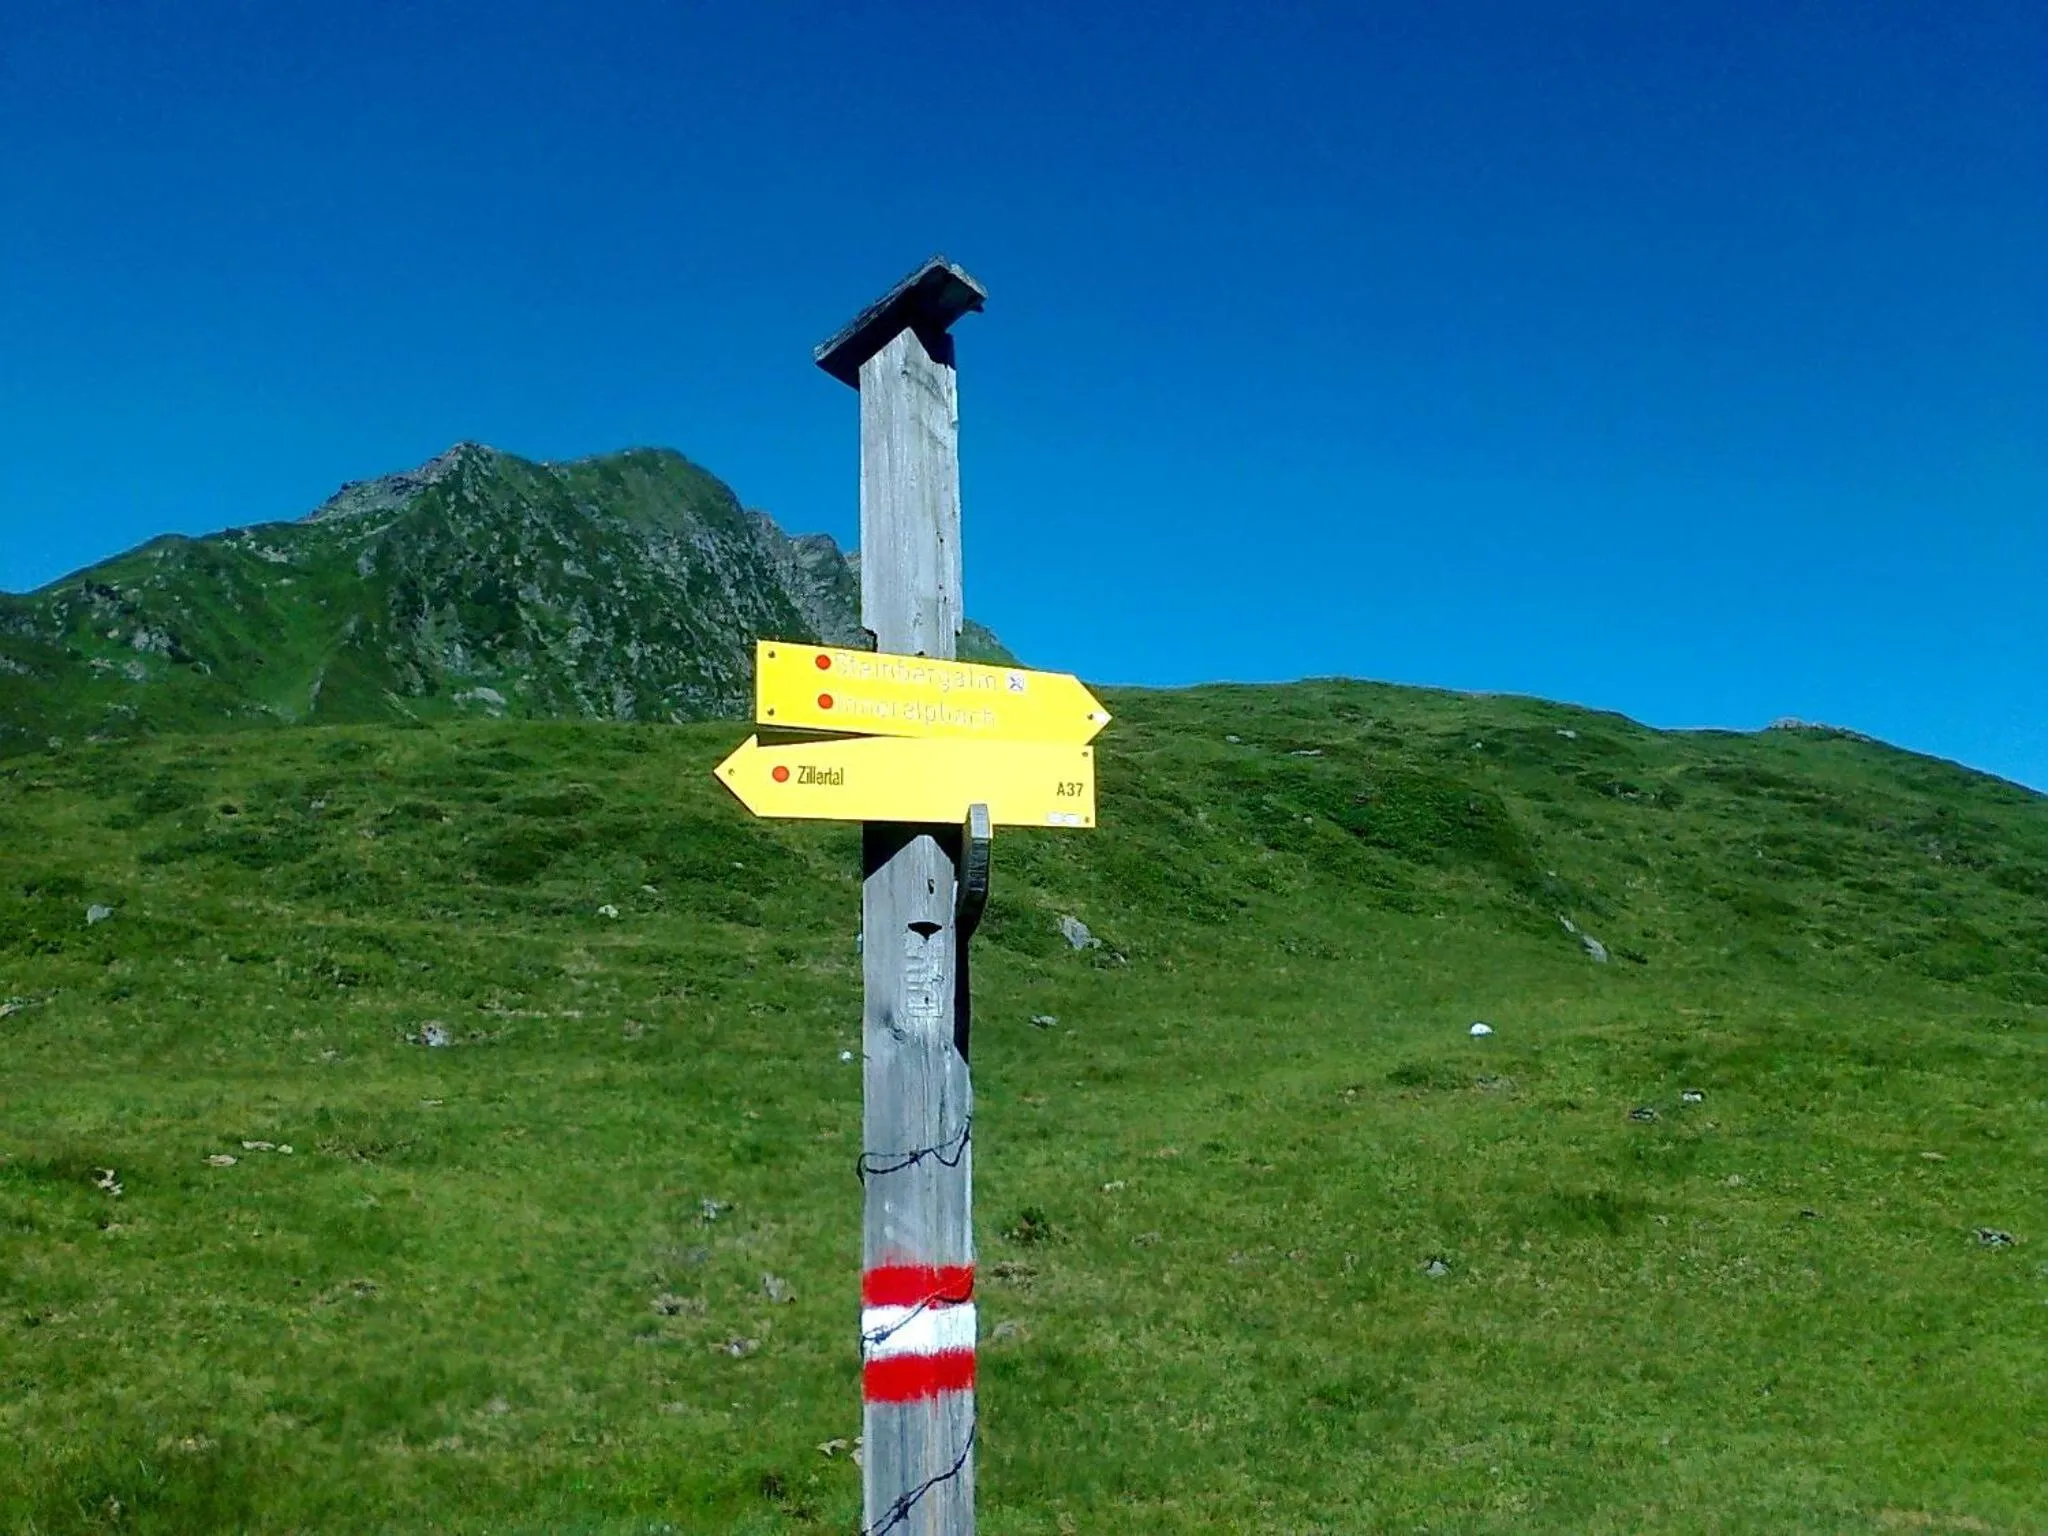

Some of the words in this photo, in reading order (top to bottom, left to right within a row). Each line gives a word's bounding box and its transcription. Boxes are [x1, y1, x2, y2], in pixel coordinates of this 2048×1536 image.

[835, 652, 997, 692] Steinbergalm
[797, 765, 844, 785] Zillertal
[1056, 781, 1084, 797] A37
